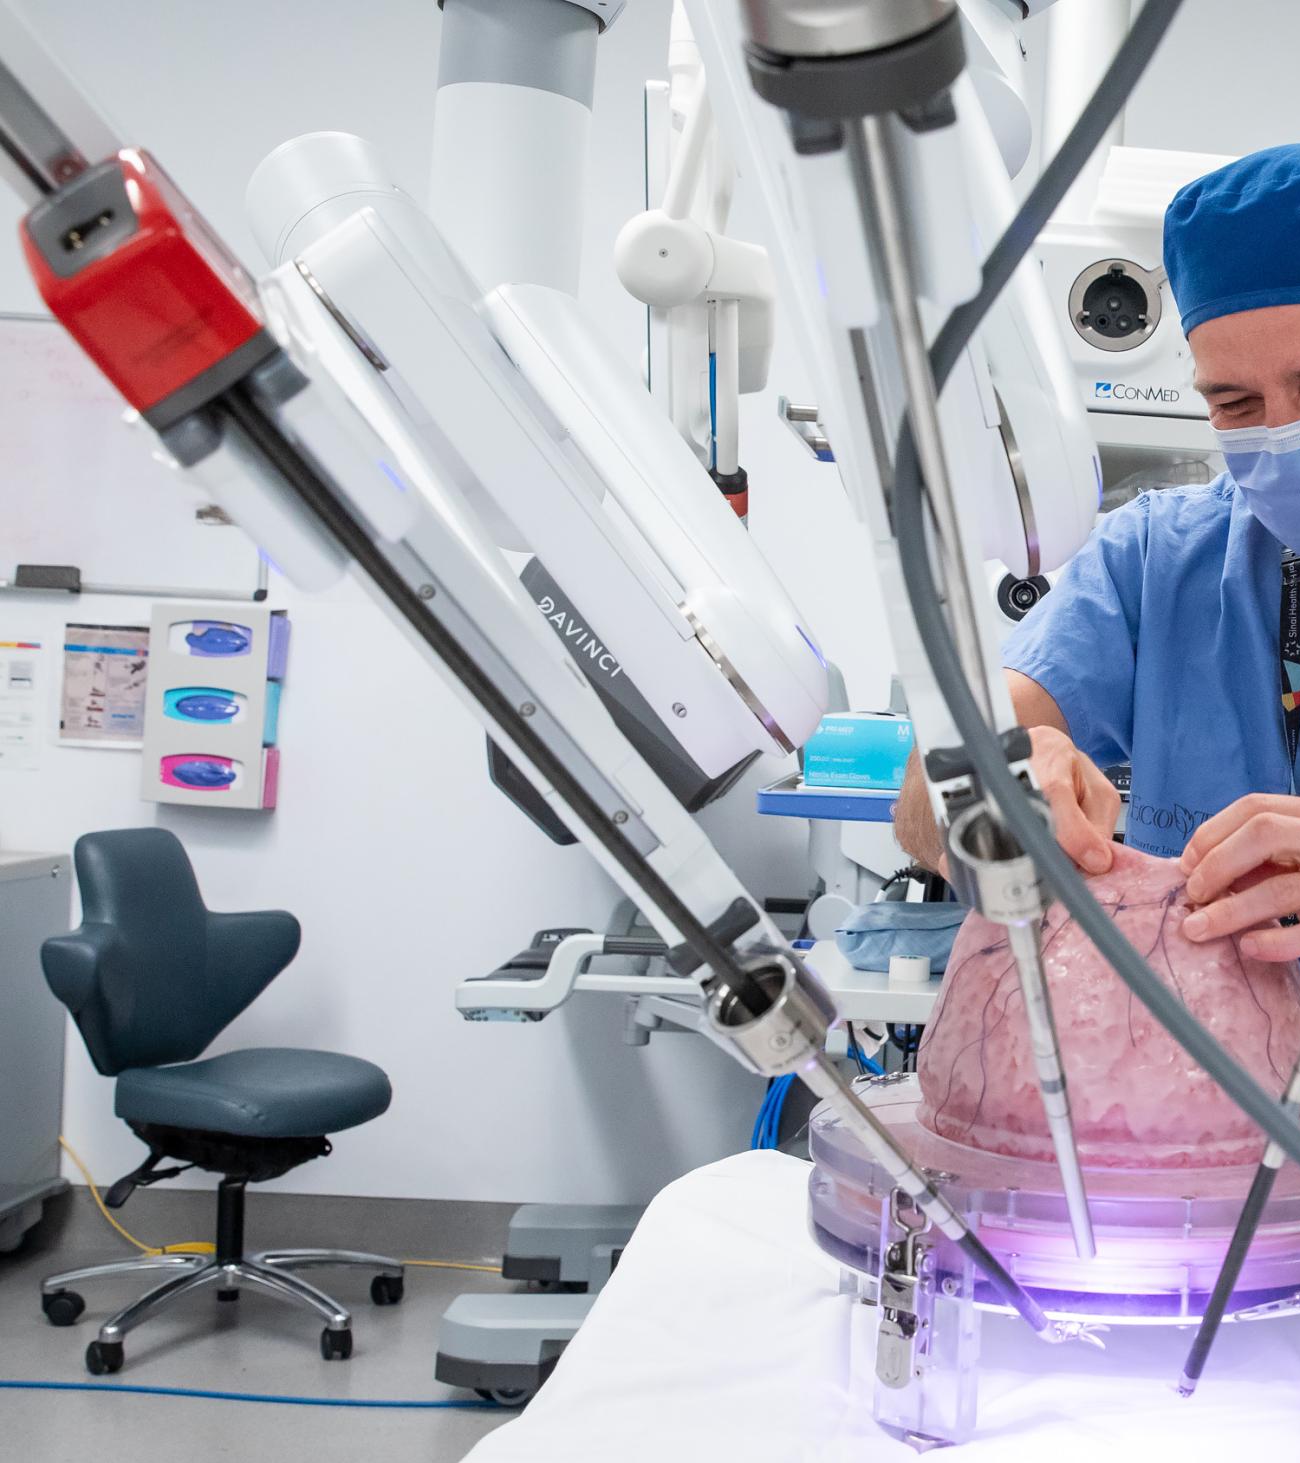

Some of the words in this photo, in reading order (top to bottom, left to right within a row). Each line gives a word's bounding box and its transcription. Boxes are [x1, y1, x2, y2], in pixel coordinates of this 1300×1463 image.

[1289, 588, 1297, 615] Health
[537, 596, 622, 678] DAVINCI
[1289, 616, 1297, 638] Sinai
[897, 725, 910, 736] M
